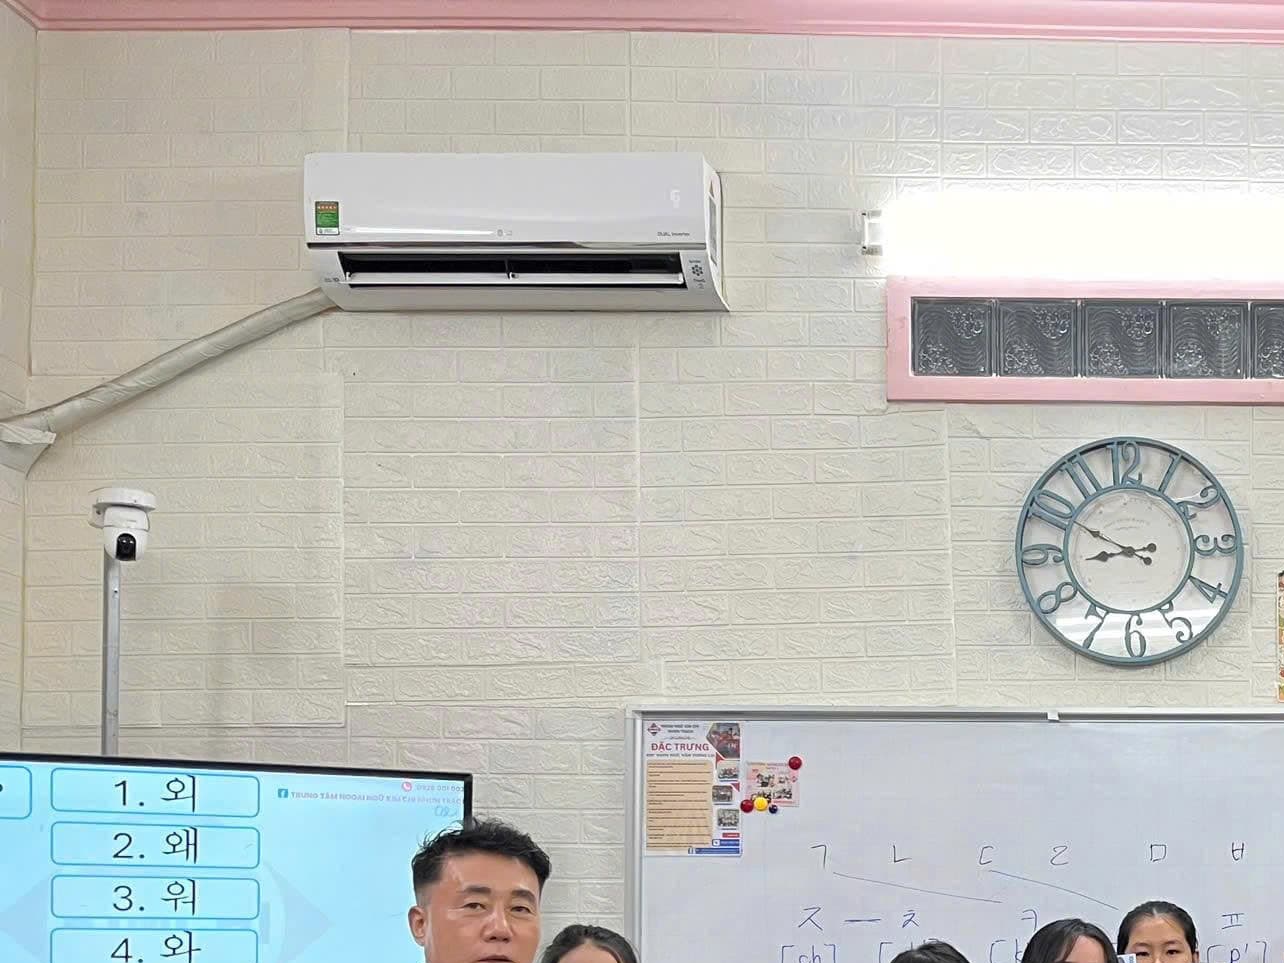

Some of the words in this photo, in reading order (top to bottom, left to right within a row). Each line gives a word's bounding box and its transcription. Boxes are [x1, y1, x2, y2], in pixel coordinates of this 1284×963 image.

[1059, 453, 1103, 499] 11
[1106, 441, 1143, 487] 12
[1158, 452, 1183, 494] 1
[1027, 489, 1075, 531] 10
[1176, 485, 1220, 520] 2
[1022, 543, 1064, 566] 9
[1193, 533, 1238, 556] 3
[1038, 581, 1078, 615] 8
[1189, 575, 1229, 604] 4
[1082, 603, 1109, 650] 7
[1124, 612, 1147, 658] 6
[1159, 599, 1194, 644] 5
[651, 741, 672, 753] ĐẶC
[674, 742, 710, 751] TRƯNG
[114, 779, 145, 807] 1.
[160, 775, 196, 813] 외
[112, 831, 146, 860] 2.
[161, 827, 198, 864] 왜
[112, 885, 146, 912] 3.
[110, 938, 144, 963] 4.
